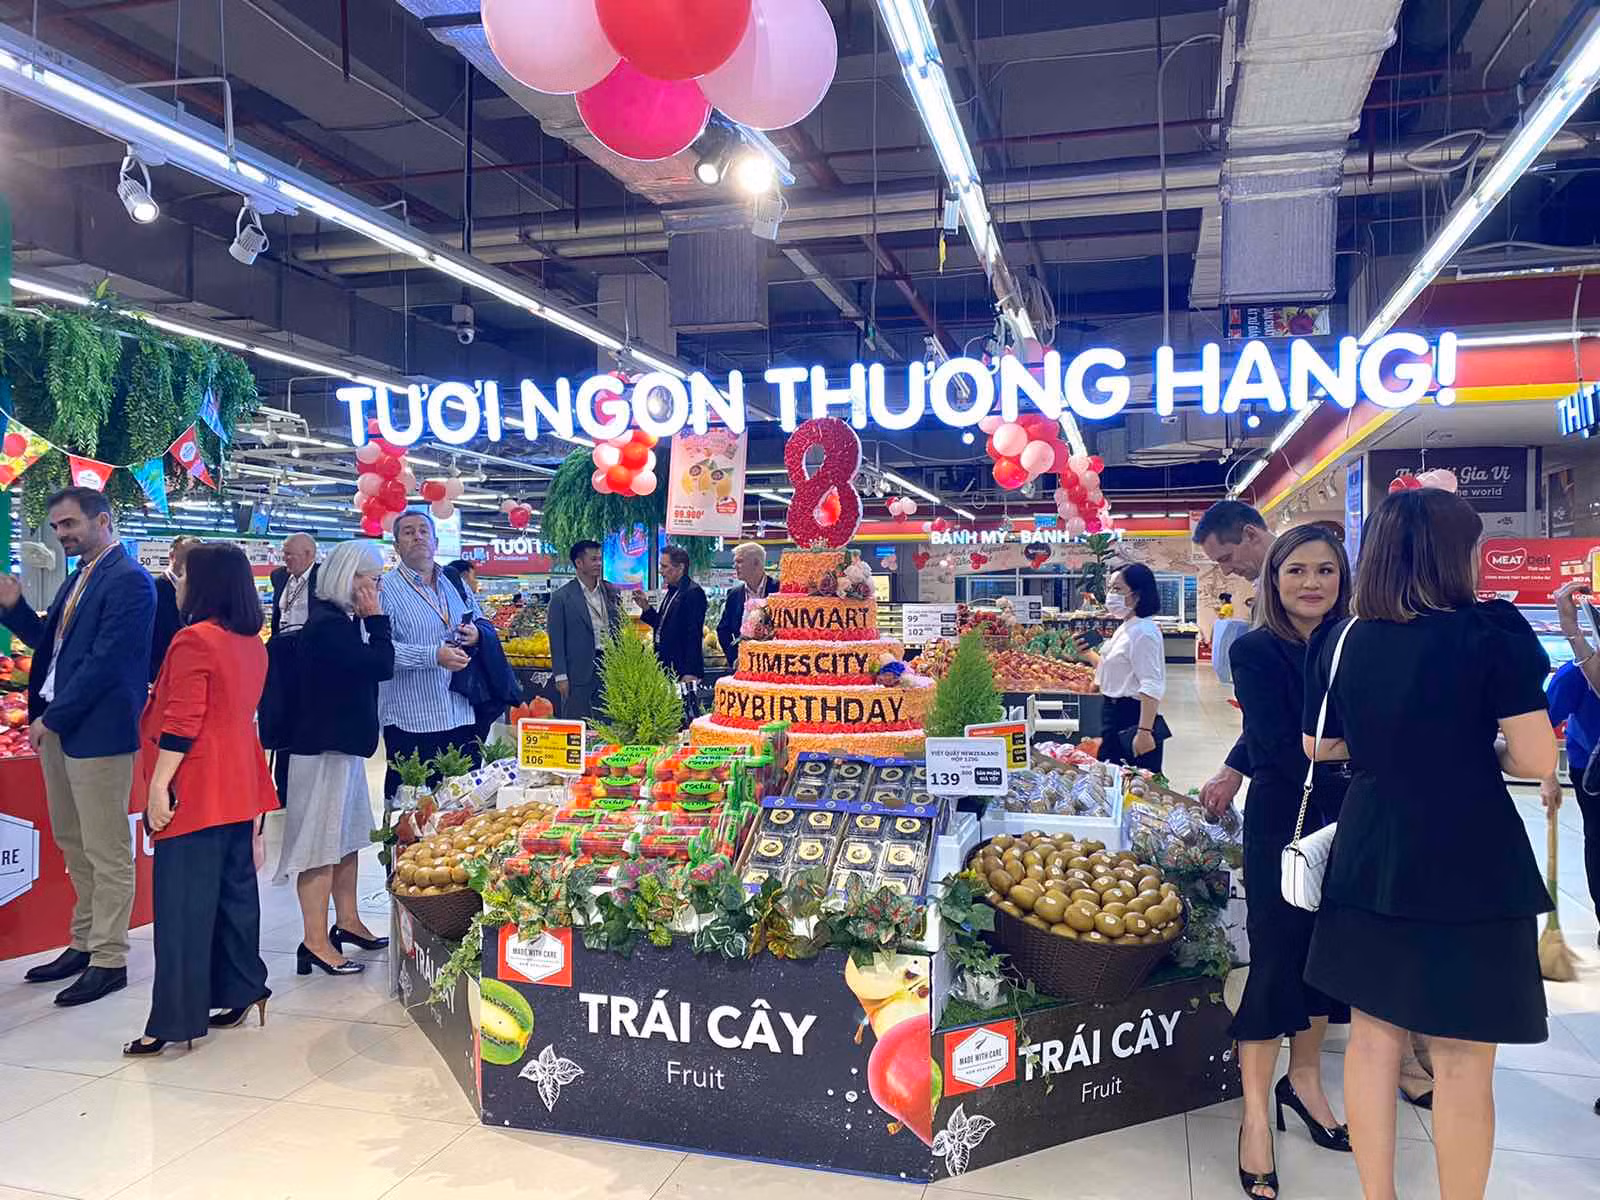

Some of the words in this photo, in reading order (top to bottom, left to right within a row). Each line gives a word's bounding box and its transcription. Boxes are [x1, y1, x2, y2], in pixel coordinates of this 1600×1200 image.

[336, 380, 500, 448] TƯƠI
[519, 368, 746, 441] NGON
[763, 347, 1132, 446] THƯỢNG
[1155, 331, 1458, 428] HẠNG!
[784, 418, 864, 550] 8
[1459, 466, 1489, 484] Gia
[1491, 466, 1512, 483] Vị
[1471, 487, 1503, 496] world
[931, 529, 977, 544] BÁNH
[1020, 526, 1070, 544] BÁNH
[1491, 556, 1523, 565] MEAT
[907, 615, 919, 623] 99
[908, 628, 924, 636] 102
[526, 735, 538, 744] 99
[525, 755, 543, 764] 106
[931, 772, 960, 785] 139
[543, 950, 557, 959] CARE
[578, 989, 693, 1044] TRÁI
[706, 998, 818, 1057] CÂY
[1017, 1023, 1101, 1081] TRÁI
[1110, 1008, 1182, 1060] CÂY
[959, 1054, 974, 1066] MADE
[974, 1051, 989, 1062] WITH
[989, 1047, 1002, 1059] CARE
[666, 1060, 726, 1091] Fruit
[1080, 1076, 1123, 1103] Fruit
